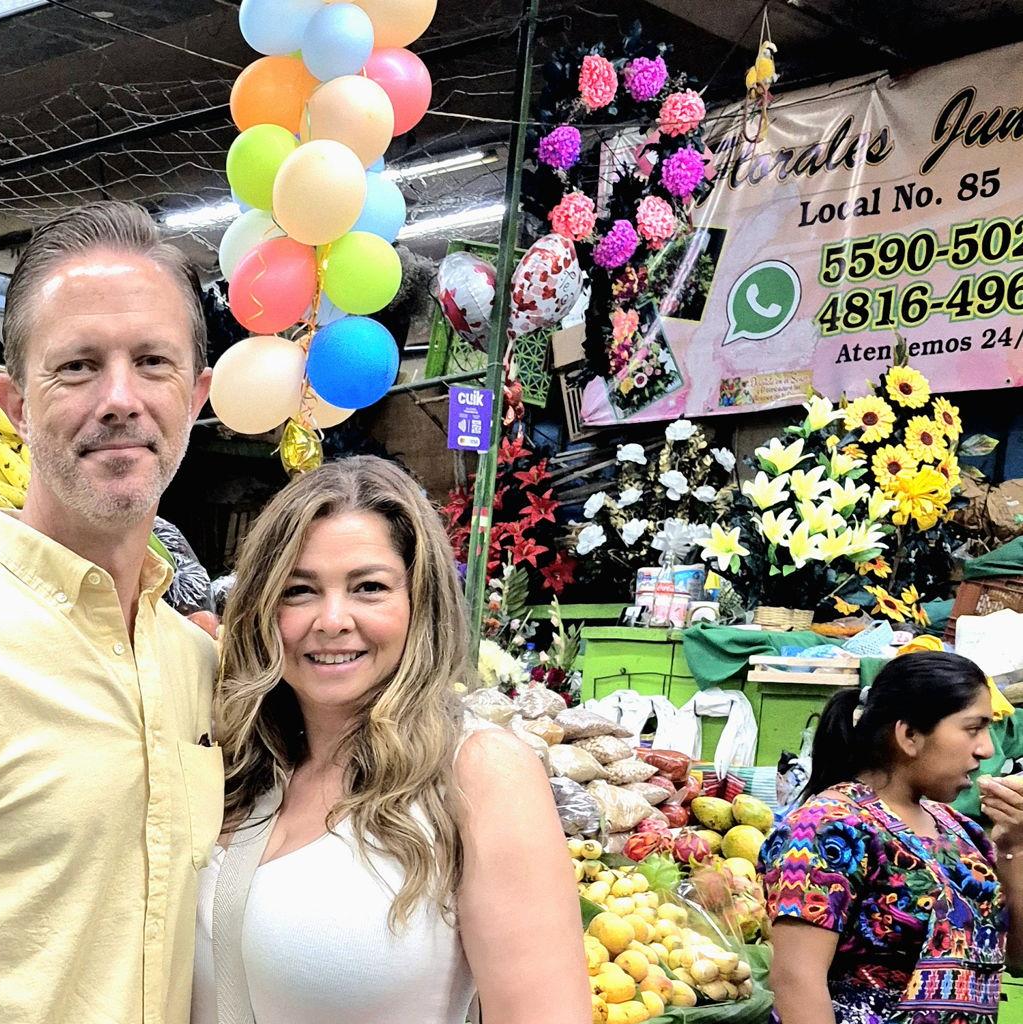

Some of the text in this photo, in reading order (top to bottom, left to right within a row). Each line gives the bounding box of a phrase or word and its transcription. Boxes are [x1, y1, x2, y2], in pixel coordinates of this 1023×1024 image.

[798, 167, 1001, 227] Local No. 85
[835, 336, 972, 364] Atenemos
